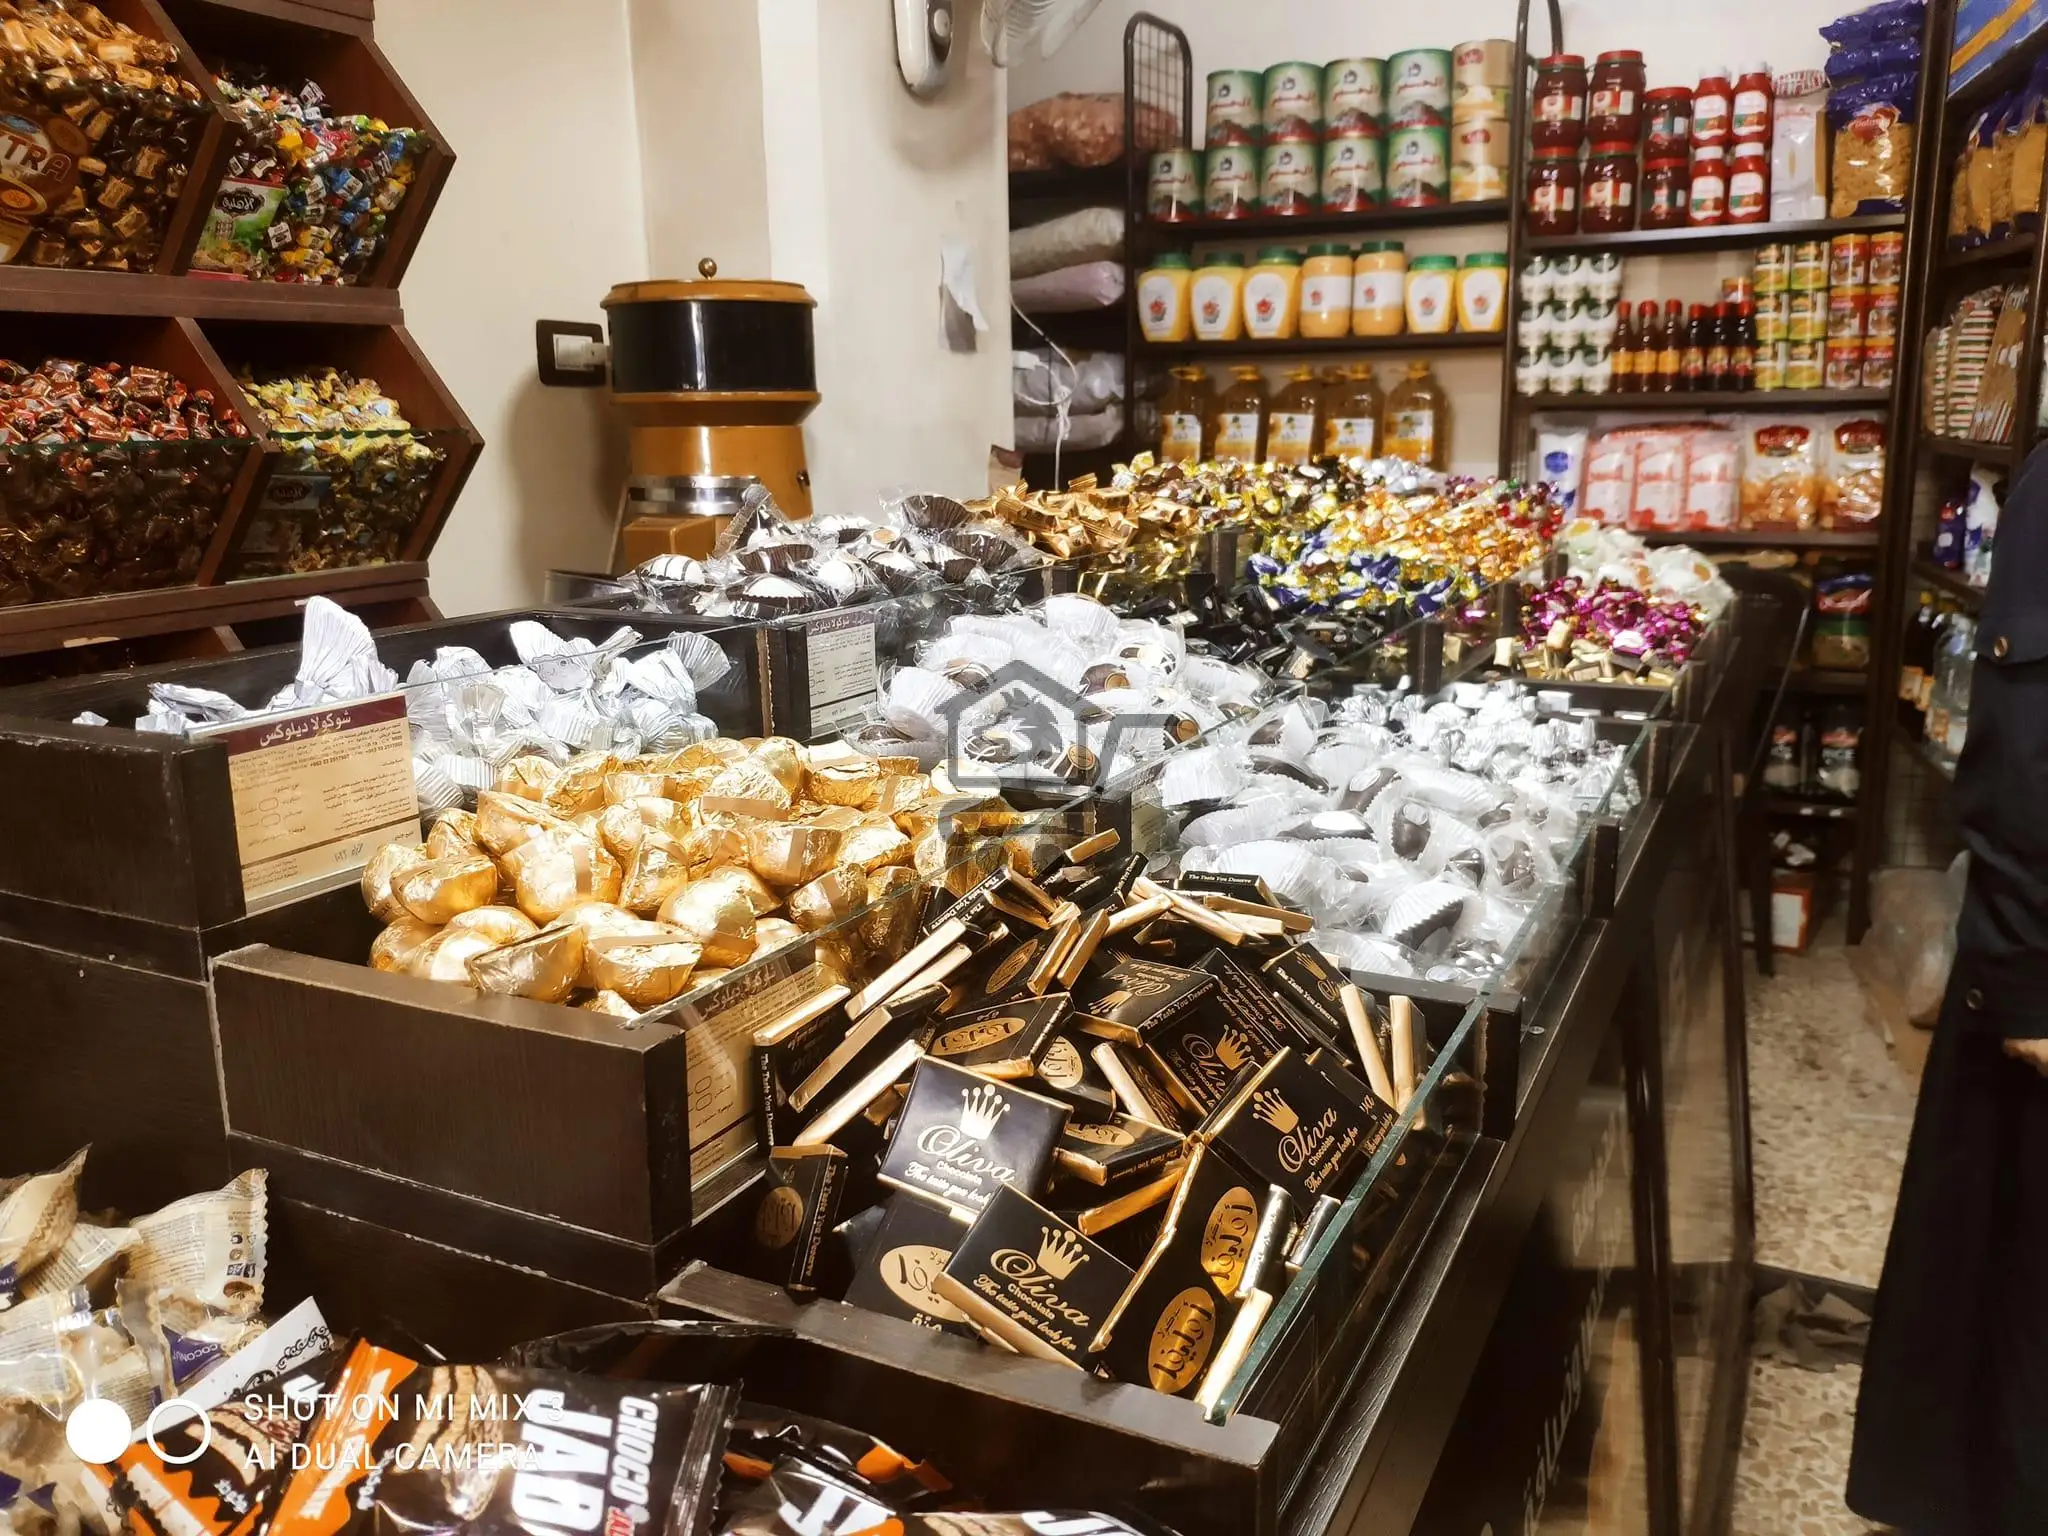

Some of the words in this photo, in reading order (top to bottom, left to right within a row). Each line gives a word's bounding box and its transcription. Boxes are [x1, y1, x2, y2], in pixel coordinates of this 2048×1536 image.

[4, 133, 72, 183] TRA
[260, 724, 308, 747] ديلوكس
[311, 709, 351, 734] شوكولا
[984, 877, 999, 890] The
[1143, 1018, 1157, 1030] The
[1156, 1006, 1175, 1023] Taste
[1173, 998, 1189, 1012] You
[1188, 983, 1214, 1005] Deserve
[1276, 967, 1290, 980] The
[1287, 977, 1305, 993] Taste
[1303, 991, 1318, 1007] You
[1313, 1002, 1341, 1030] Deserve
[760, 1053, 769, 1070] The
[1190, 1062, 1223, 1100] Chocolate
[763, 1094, 772, 1111] You
[917, 1125, 1016, 1182] Oliva
[1278, 1106, 1338, 1174] Oliva
[1308, 1135, 1336, 1166] Chocolate
[1335, 1138, 1352, 1158] look
[1346, 1126, 1360, 1147] for
[825, 1164, 837, 1183] The
[904, 1161, 931, 1182] The
[943, 1183, 970, 1197] you
[1328, 1151, 1344, 1171] you
[1303, 1172, 1323, 1193] The
[1209, 1204, 1254, 1280] أوليفا
[990, 1248, 1090, 1328] Oliva
[1007, 1283, 1056, 1320] Chocolate
[973, 1273, 997, 1298] The
[994, 1292, 1020, 1313] taste
[1014, 1306, 1040, 1327] you
[1037, 1320, 1062, 1342] look
[1058, 1333, 1078, 1352] for
[171, 1343, 218, 1362] COCONUT
[1153, 1303, 1213, 1380] أوليفا
[609, 1395, 660, 1507] CHOCO
